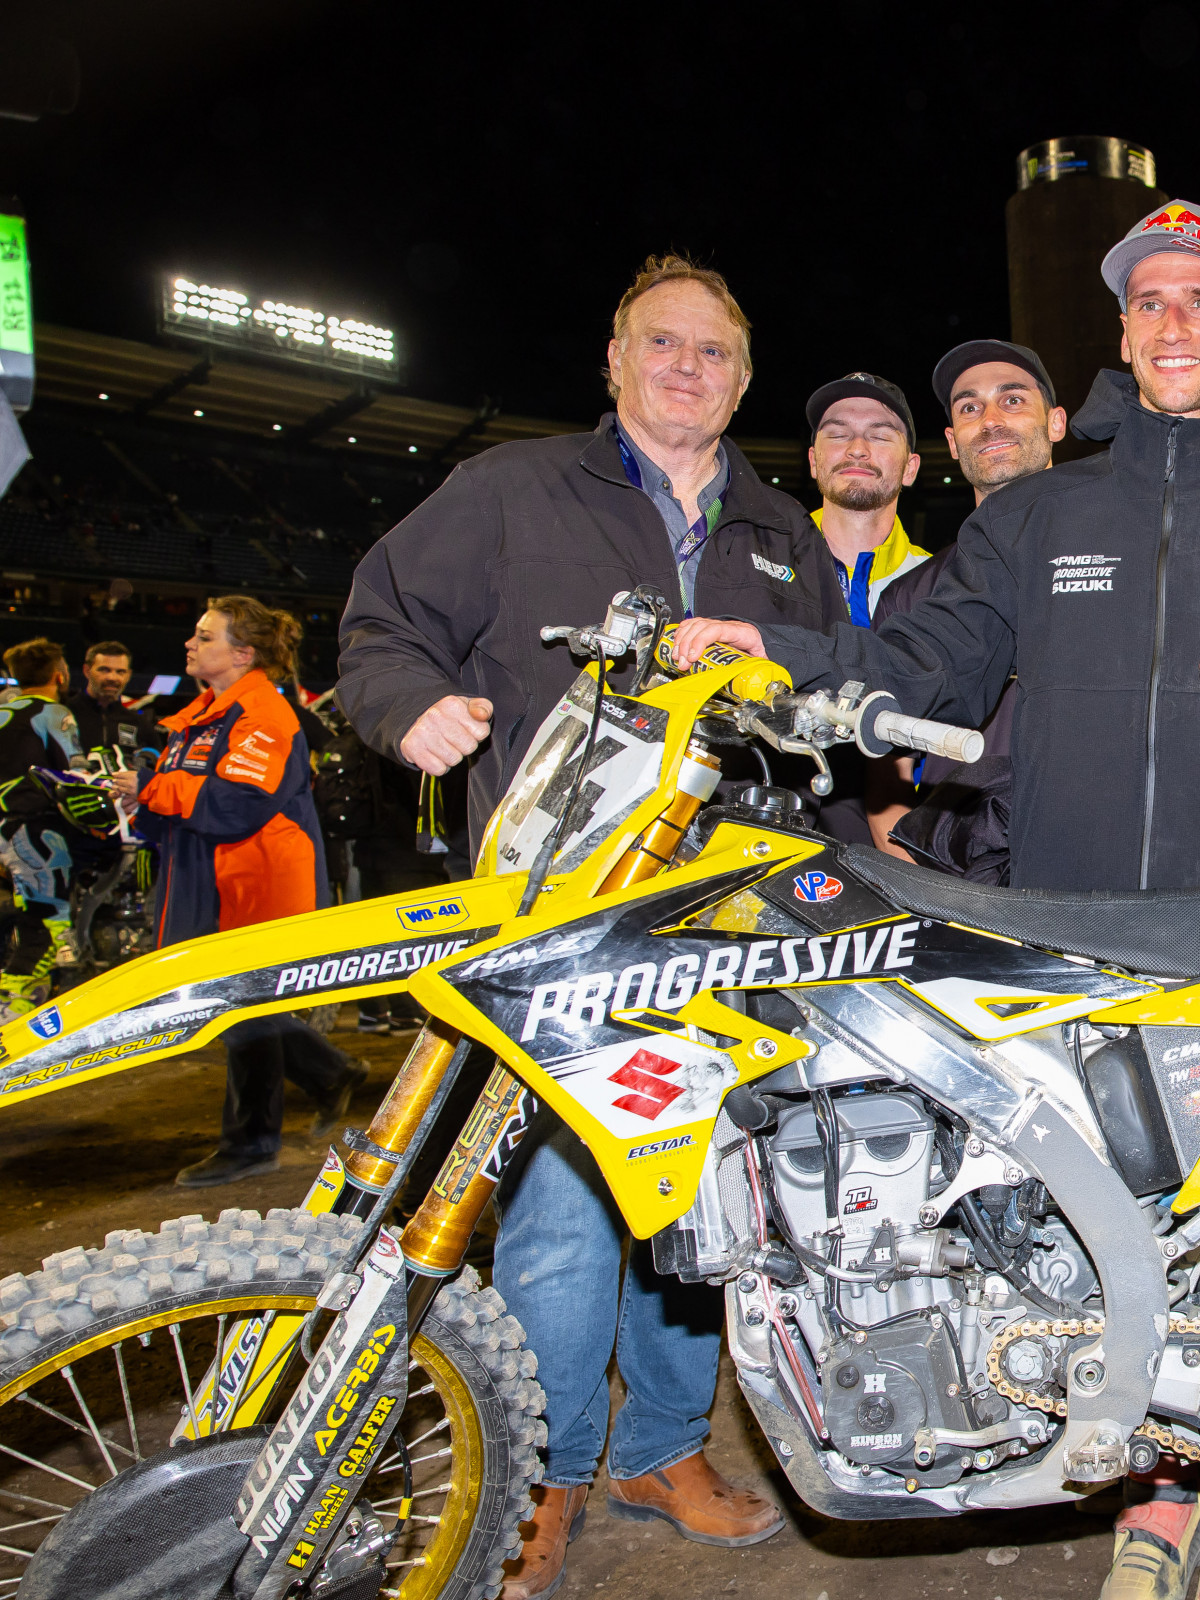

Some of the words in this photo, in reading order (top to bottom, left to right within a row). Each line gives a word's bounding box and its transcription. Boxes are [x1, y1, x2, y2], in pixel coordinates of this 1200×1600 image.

[1053, 566, 1116, 582] PROGRESSIVE
[1058, 555, 1092, 566] PMG
[1052, 579, 1113, 595] SUZUKI
[794, 871, 827, 901] VP
[404, 903, 461, 923] WD-40
[274, 939, 469, 996] PROGRESSIVE
[519, 922, 921, 1043] PROGRESSIVE
[158, 1008, 214, 1028] Power
[3, 1062, 69, 1091] PRO
[71, 1029, 185, 1069] CIRCUIT
[451, 1080, 521, 1205] SUSPENSIO
[626, 1135, 695, 1160] ECSTAR
[313, 1323, 397, 1457] ACERBIS
[338, 1396, 398, 1479] GALFER
[850, 1434, 902, 1447] HINSON
[354, 1444, 379, 1476] USA
[304, 1484, 341, 1536] HAAN
[319, 1488, 349, 1530] WHEELS
